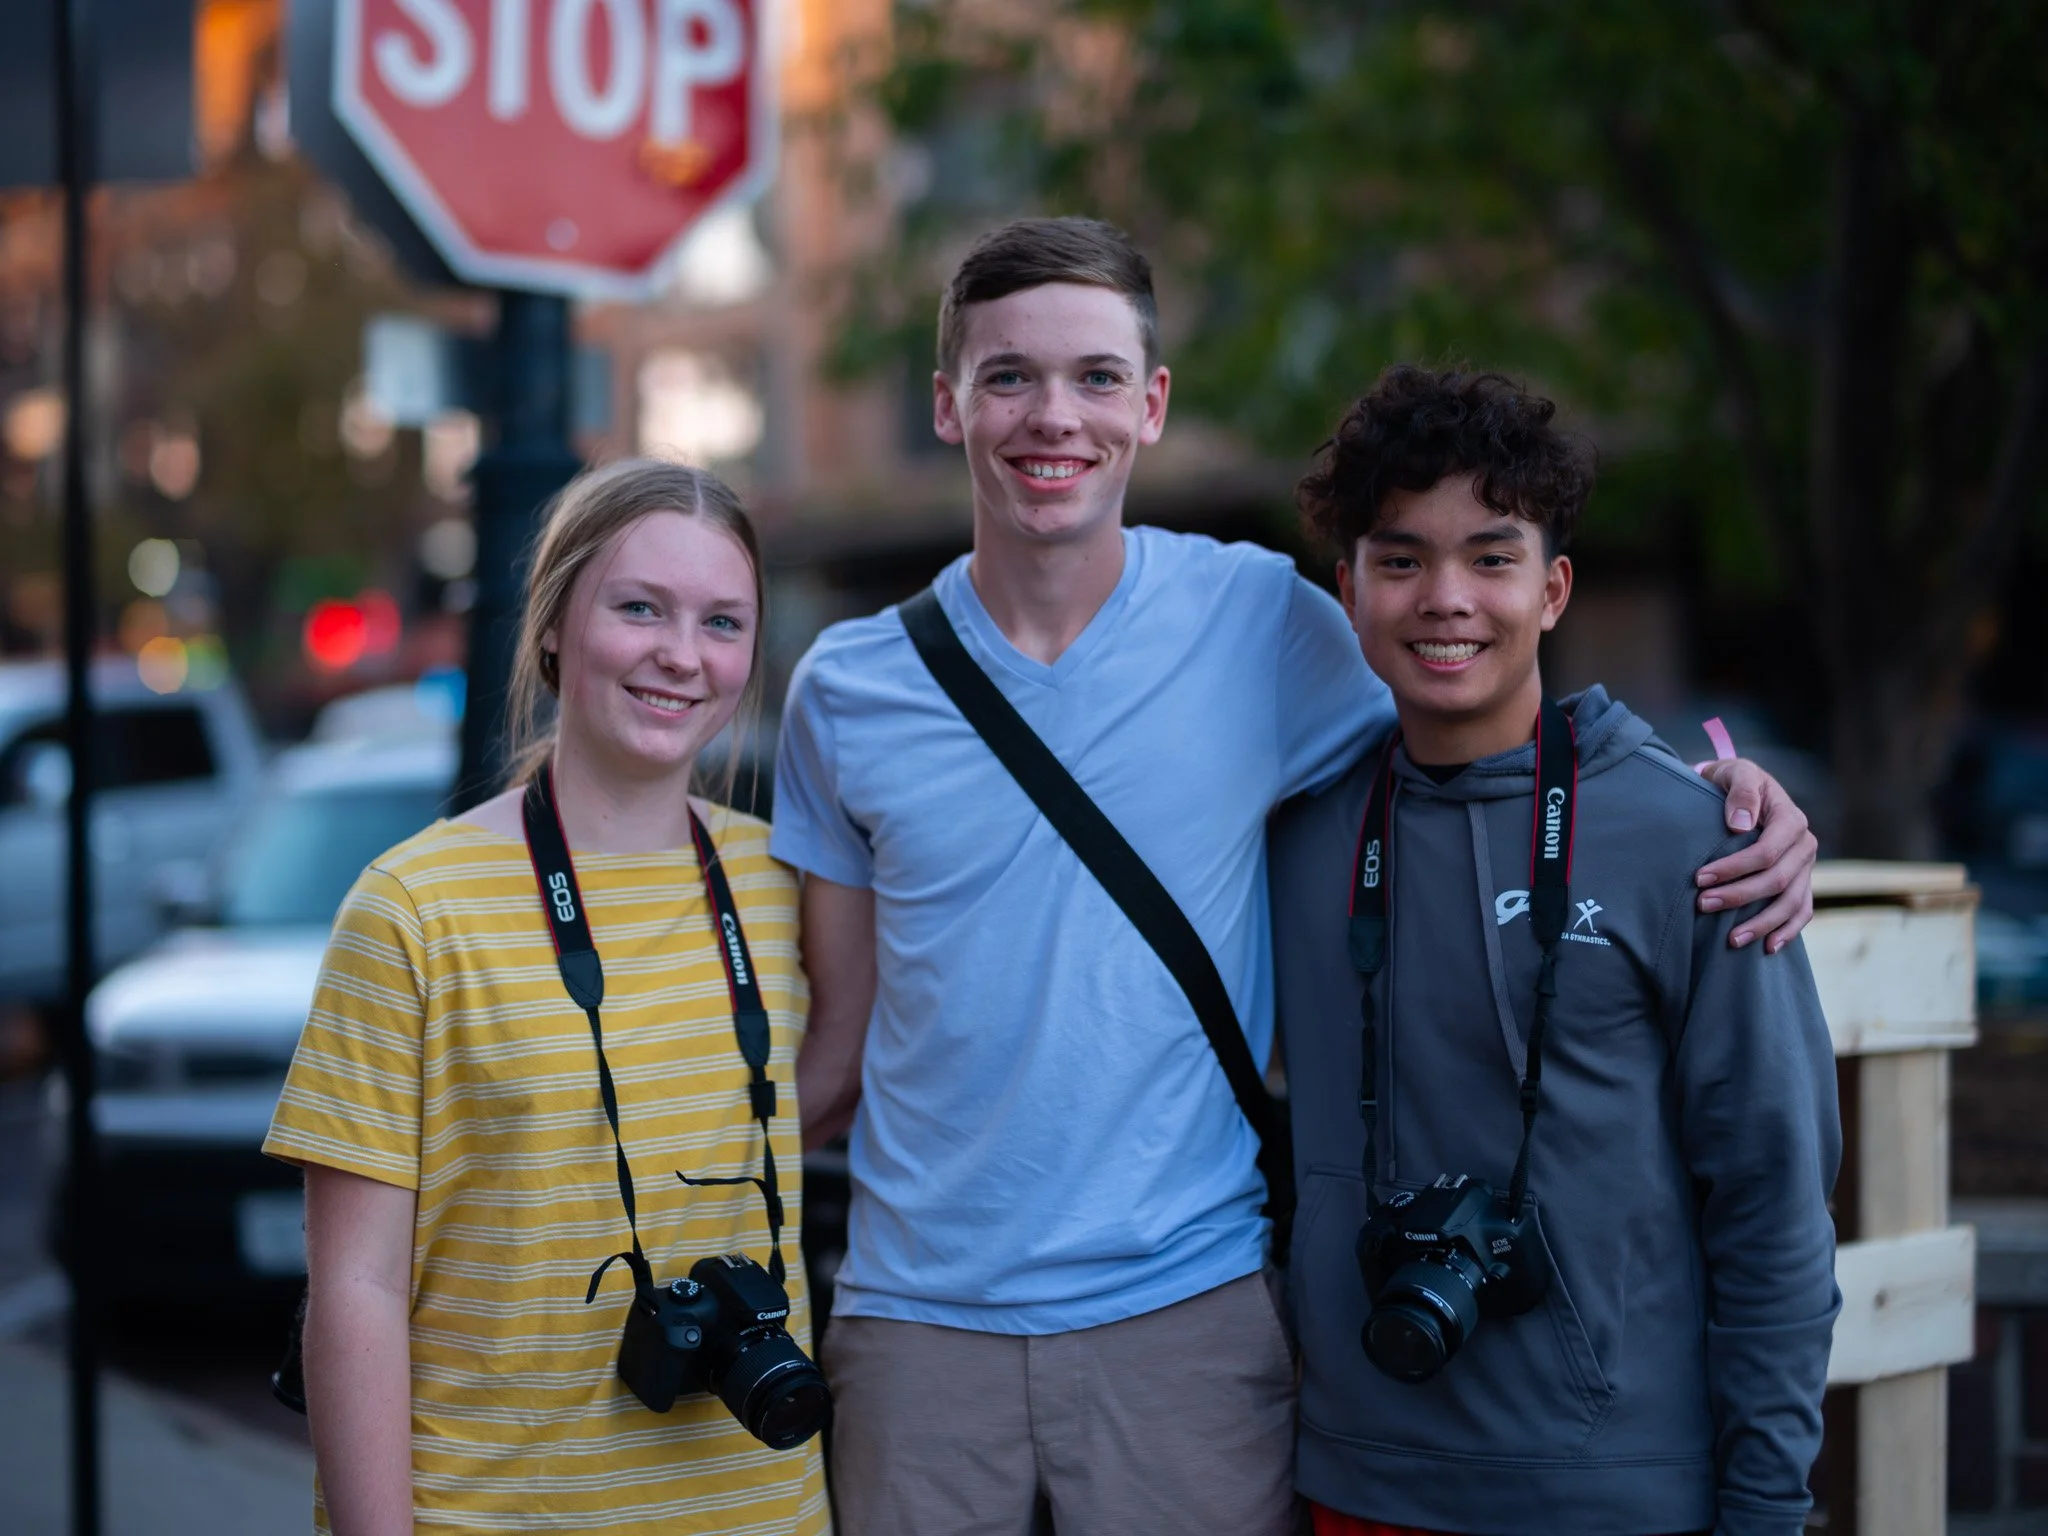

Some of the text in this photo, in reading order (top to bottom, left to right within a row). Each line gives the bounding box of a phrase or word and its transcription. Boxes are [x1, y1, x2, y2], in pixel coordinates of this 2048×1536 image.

[372, 0, 746, 148] STOP
[1544, 787, 1566, 859] Canon
[1363, 839, 1380, 888] EOS
[548, 871, 576, 922] EOS
[721, 912, 749, 985] Canon
[1561, 932, 1569, 940] SA
[1404, 1231, 1438, 1241] Canon
[757, 1309, 787, 1320] Canon
